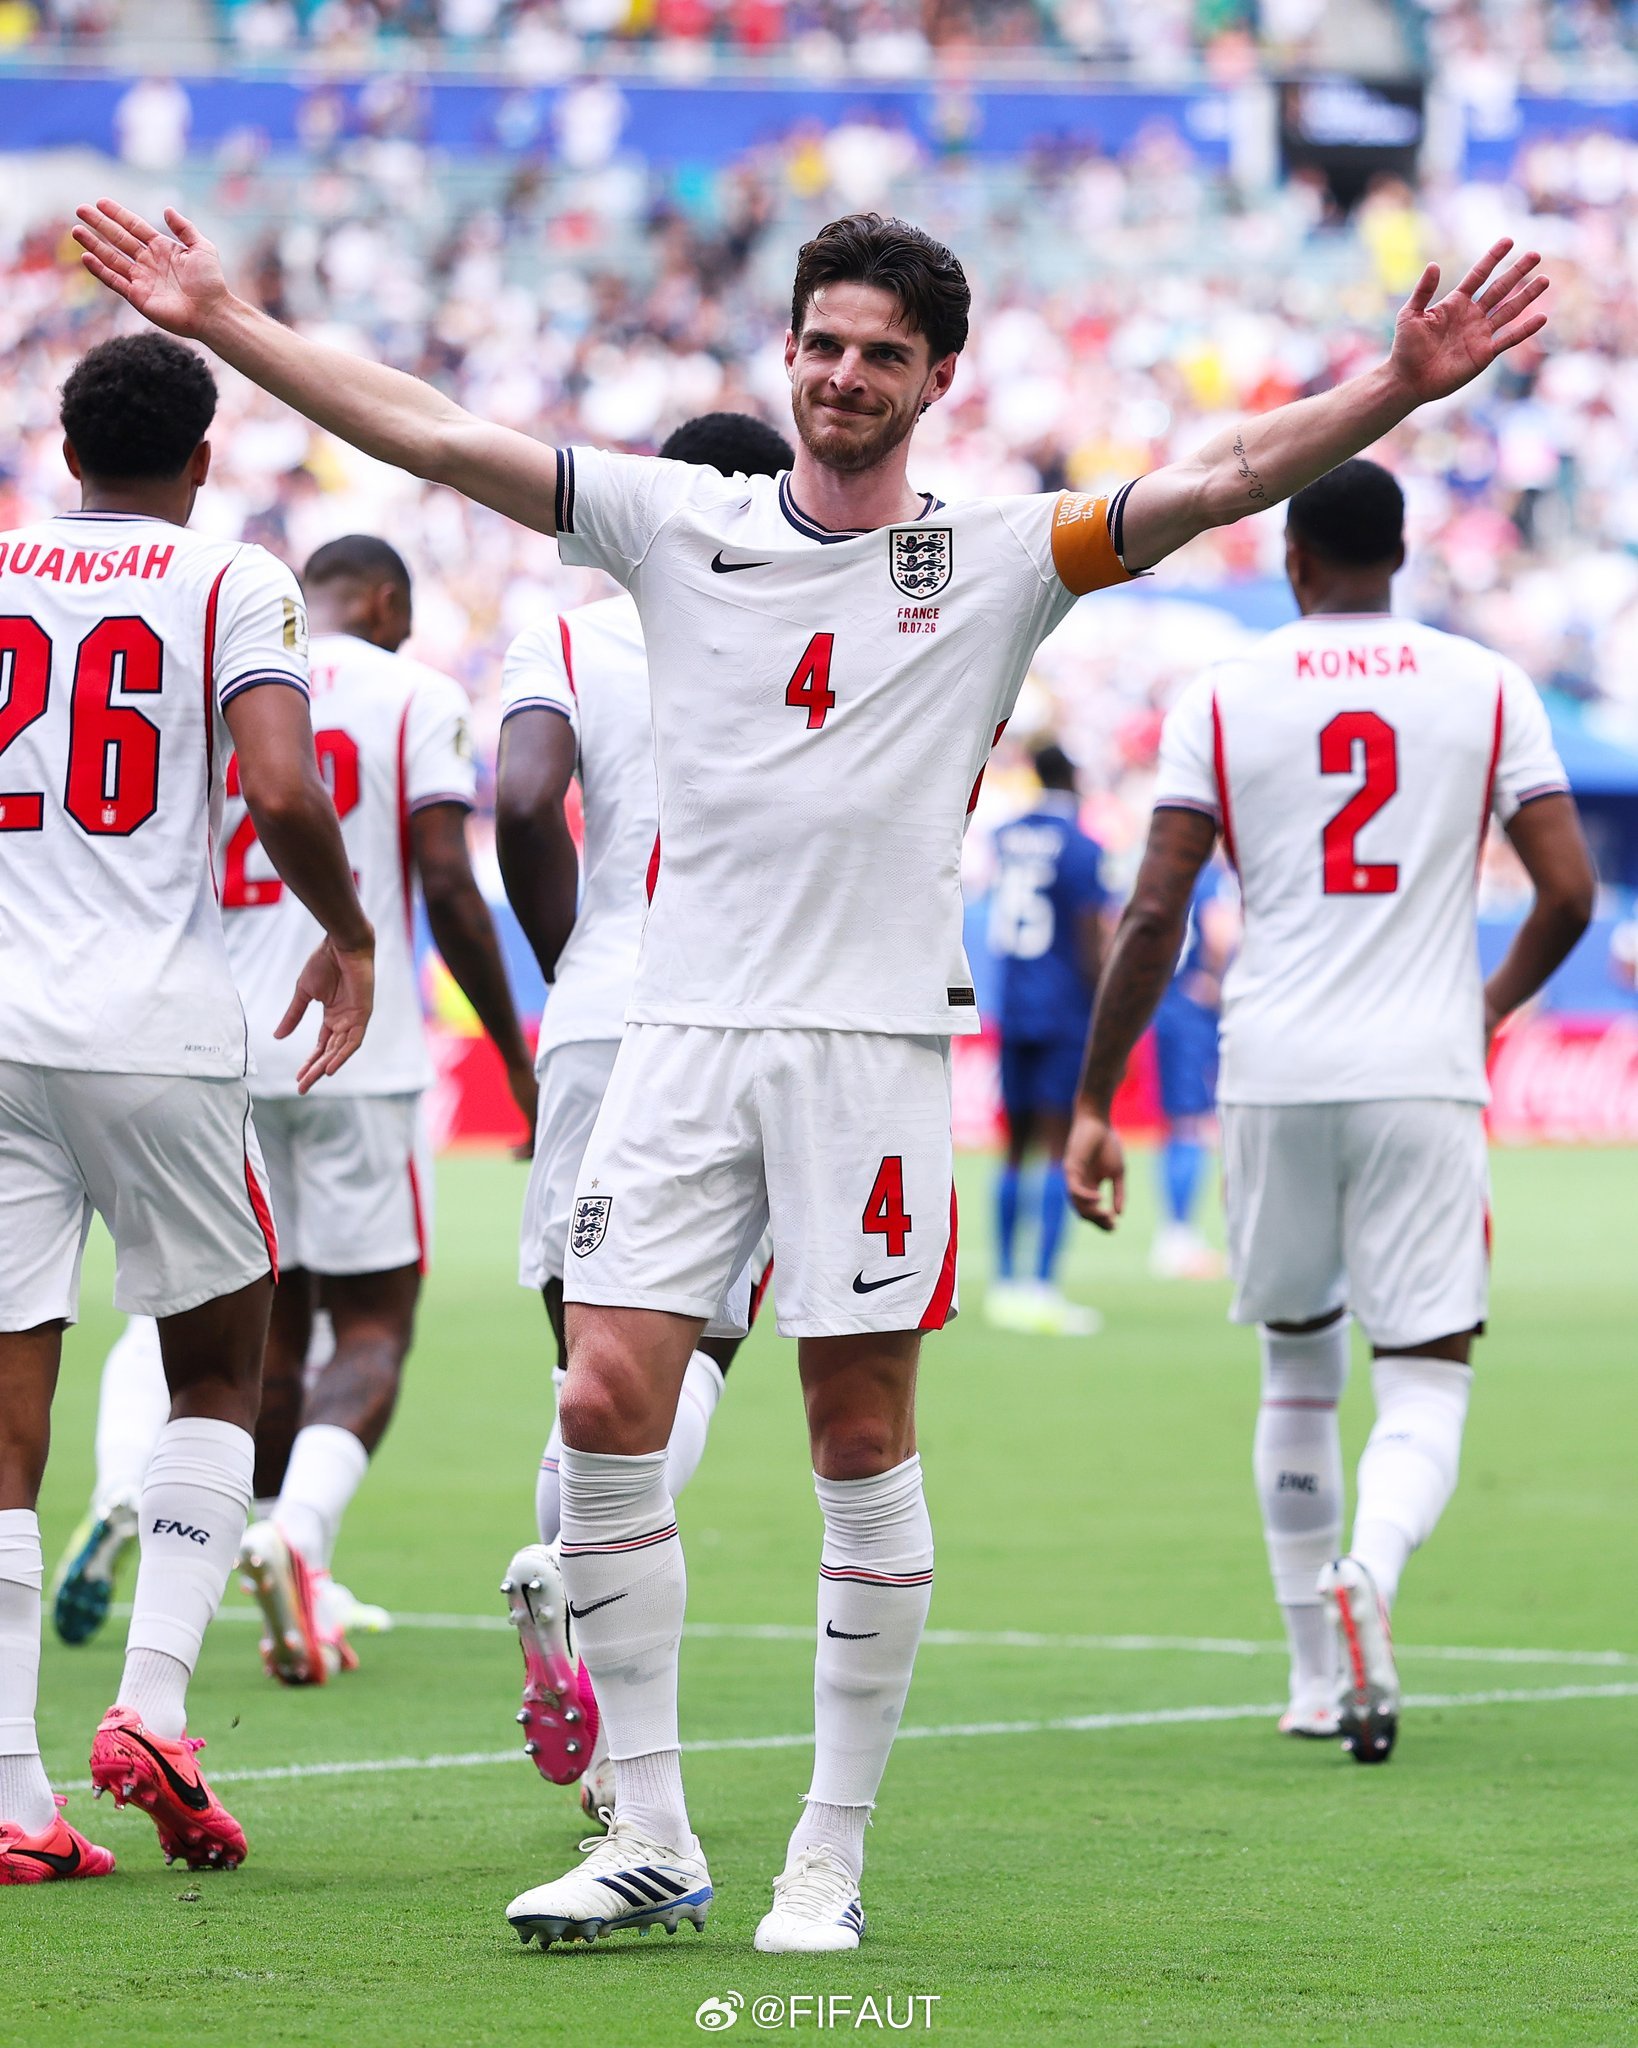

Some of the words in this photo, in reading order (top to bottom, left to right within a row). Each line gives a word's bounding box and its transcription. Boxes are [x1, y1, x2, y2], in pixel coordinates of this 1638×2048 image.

[897, 607, 940, 620] FRANCE
[898, 621, 936, 634] 18.07.26
[1296, 646, 1418, 678] KONSA
[785, 632, 836, 729] 4
[1318, 711, 1399, 895] 2
[862, 1156, 912, 1257] 4
[152, 1519, 210, 1546] ENG
